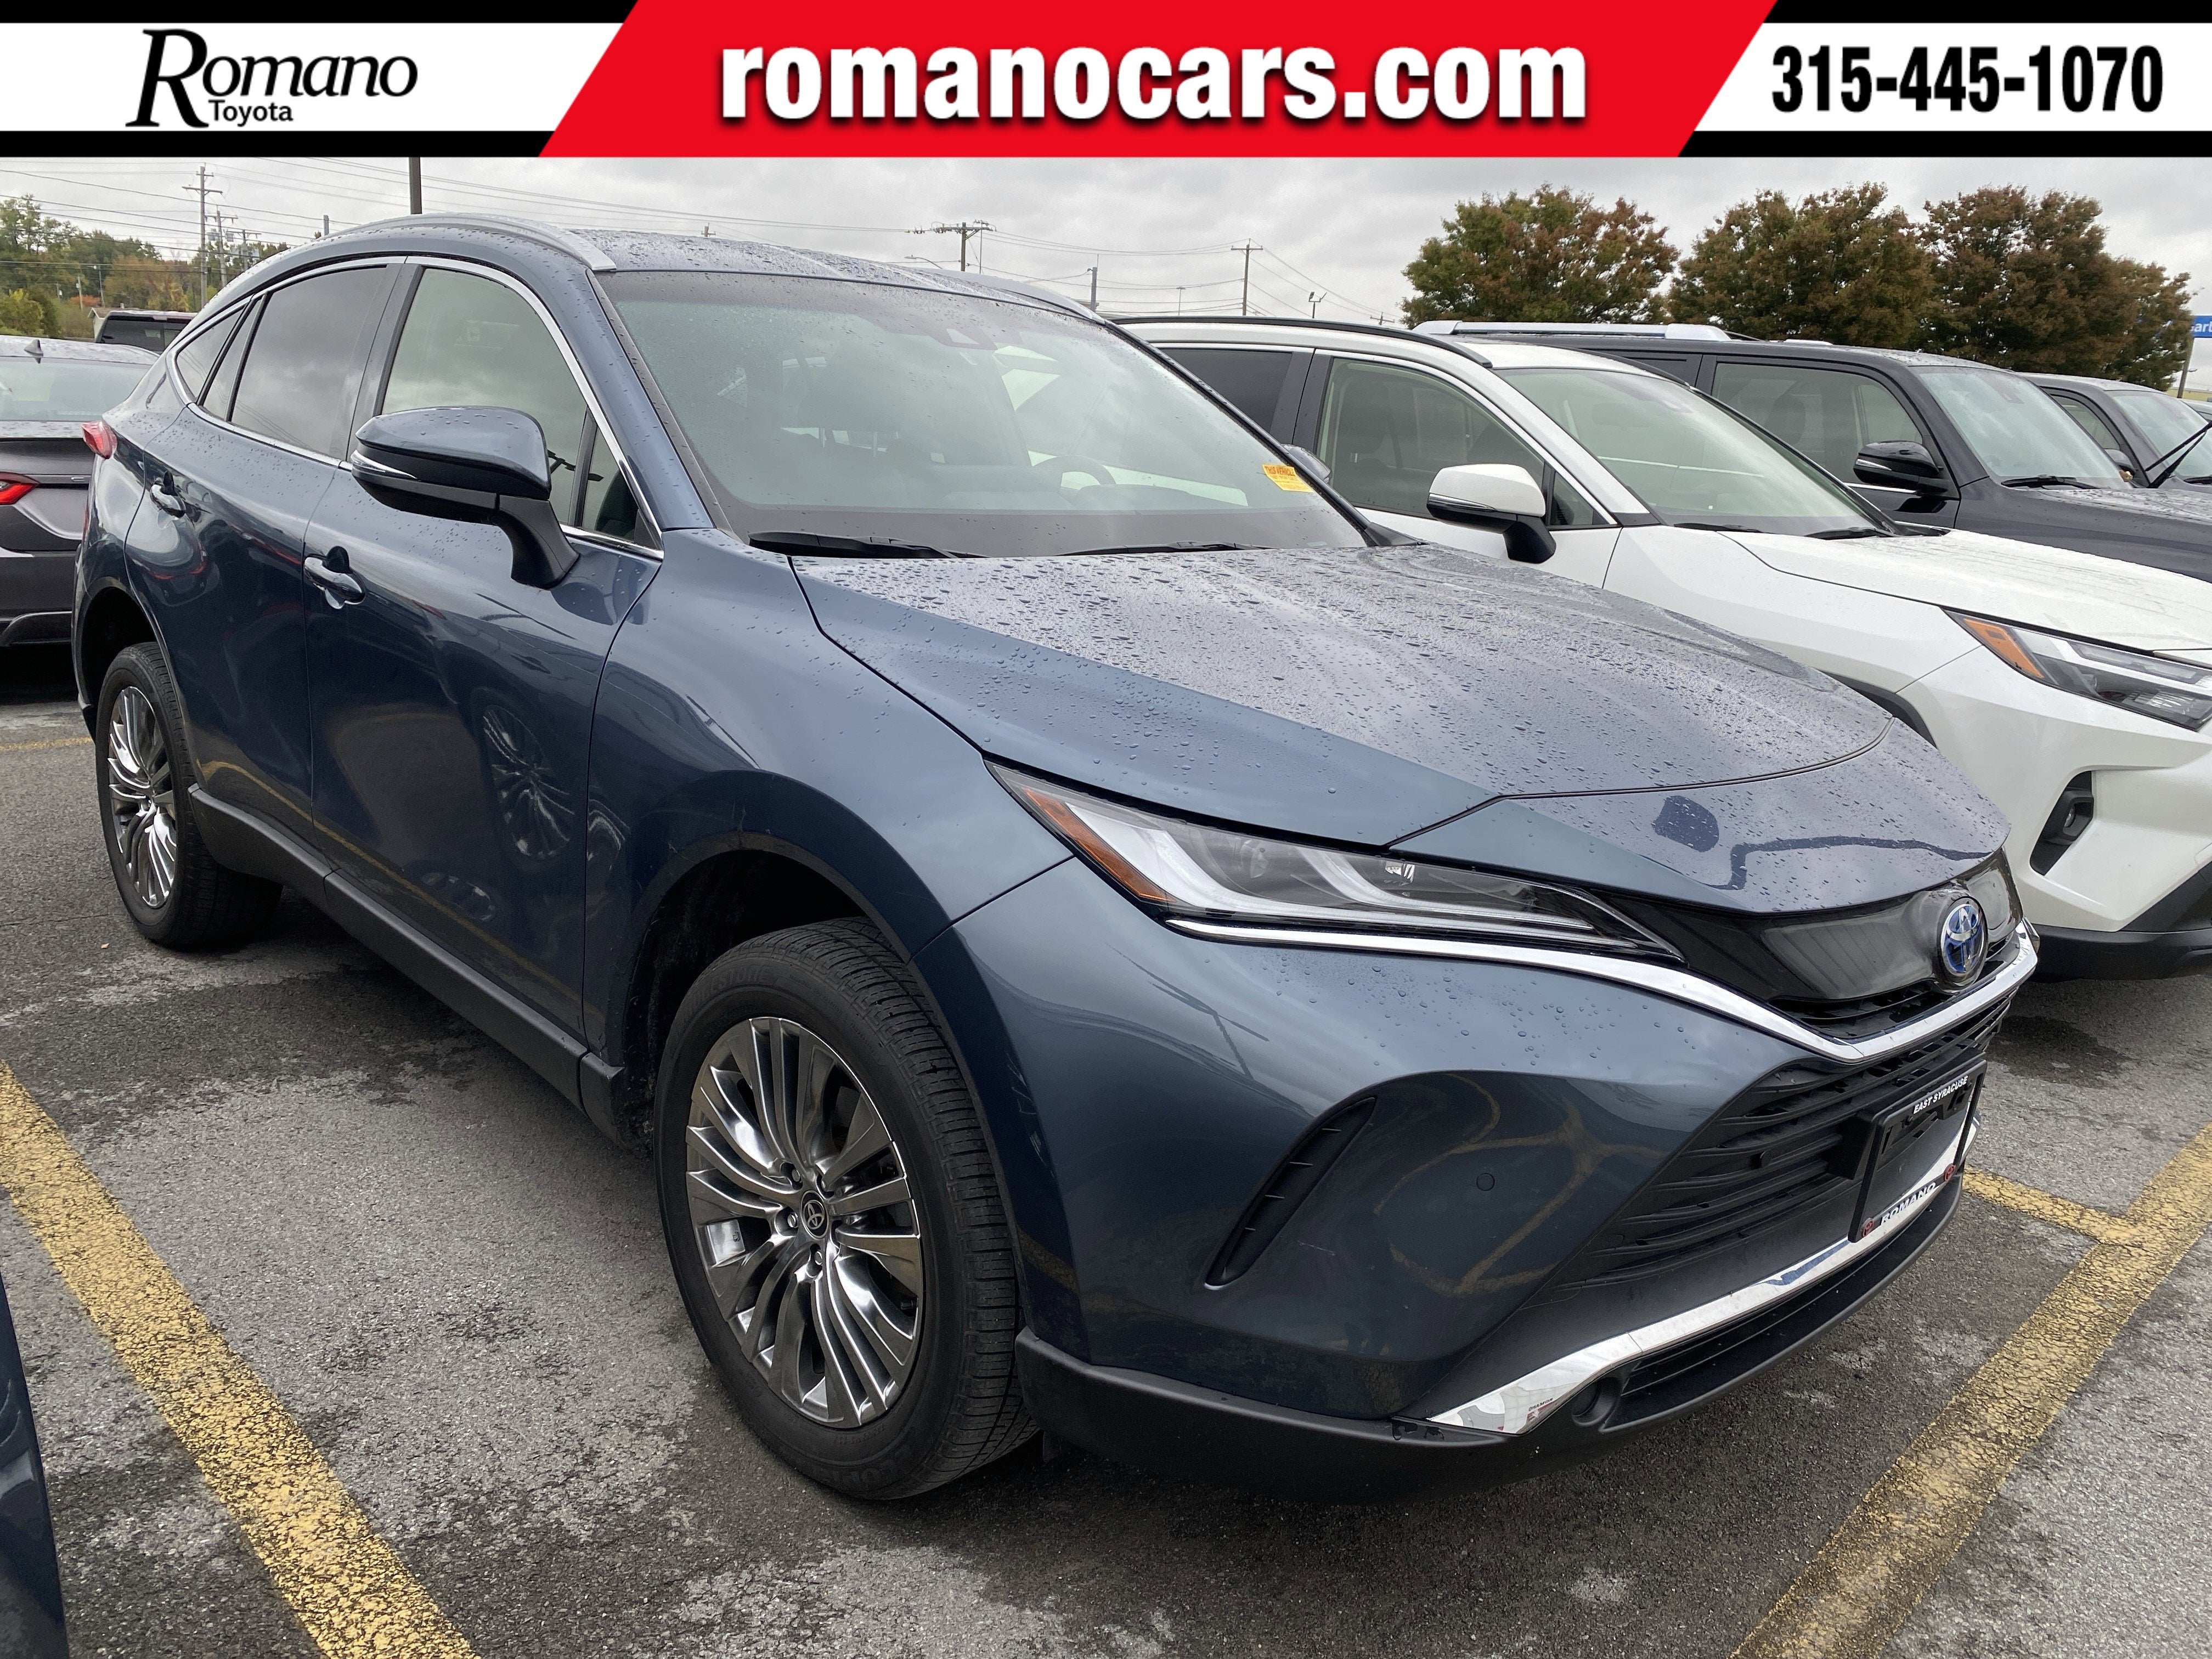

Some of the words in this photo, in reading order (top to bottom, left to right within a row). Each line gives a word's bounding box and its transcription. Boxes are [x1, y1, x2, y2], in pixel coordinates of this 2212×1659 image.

[2191, 321, 2212, 333] art
[1913, 1096, 1933, 1114] EAST
[1933, 1075, 1968, 1103] SYRACUSE
[1881, 1182, 1937, 1224] ROMANO
